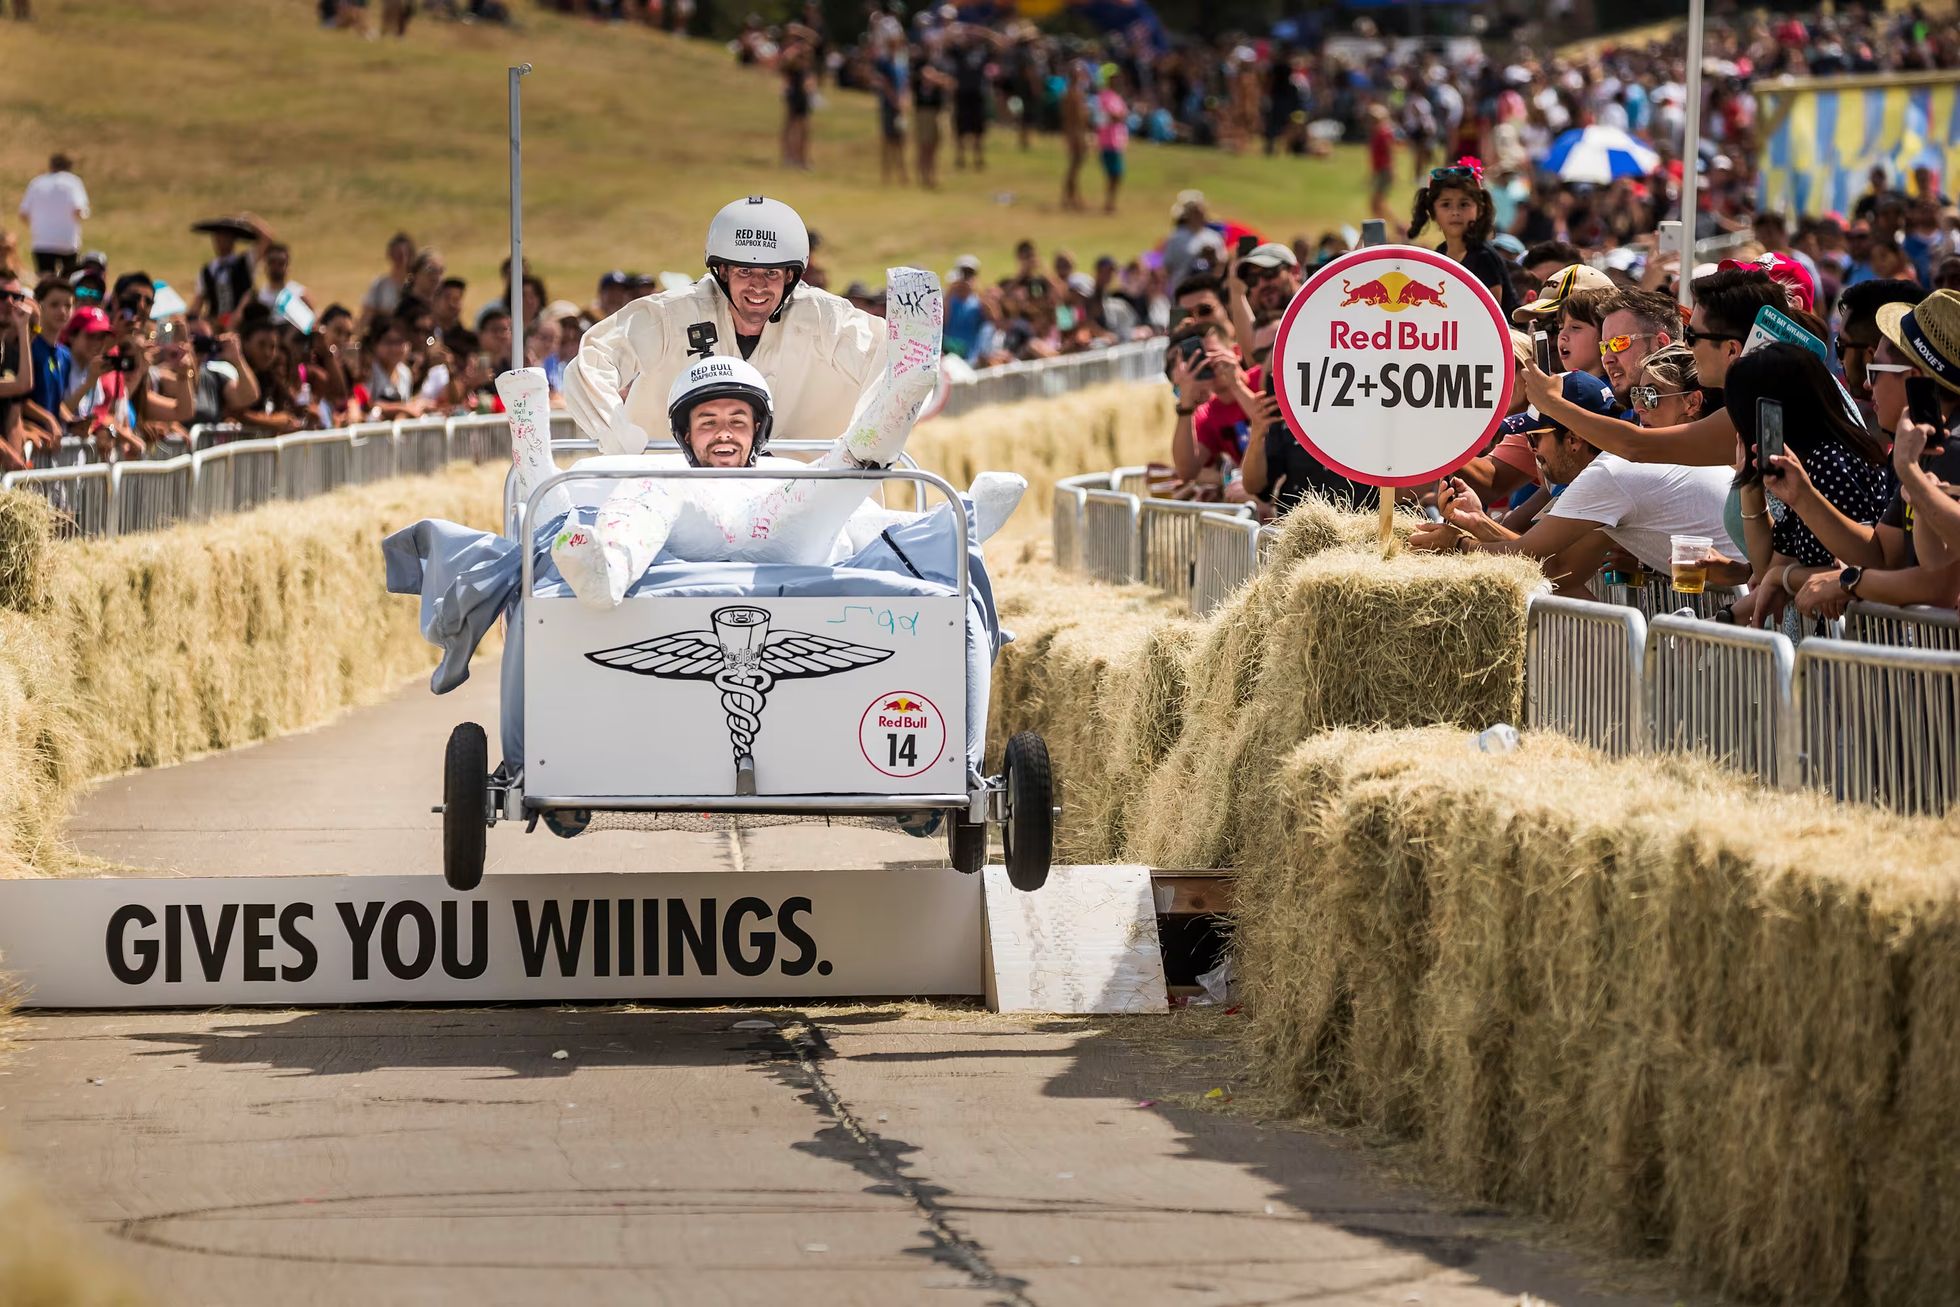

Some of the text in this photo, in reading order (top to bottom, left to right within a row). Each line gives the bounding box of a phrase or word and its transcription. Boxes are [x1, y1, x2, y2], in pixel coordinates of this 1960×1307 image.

[735, 239, 777, 249] SOAPBOX RACE
[736, 229, 777, 242] RED BULL
[1330, 320, 1459, 351] Red Bull
[1764, 309, 1777, 322] RACE
[1776, 317, 1787, 328] DAY
[1786, 323, 1810, 344] GIVEAWAY
[1913, 337, 1945, 372] MOXIE'S
[691, 363, 732, 378] RED BULL
[691, 371, 718, 383] SOAPBOX
[1297, 356, 1494, 413] 1/2+SOME
[721, 643, 764, 664] Red Bull
[879, 716, 927, 729] Red Bull
[887, 733, 918, 768] 14
[106, 896, 834, 985] GIVES YOU WIIINGS.
